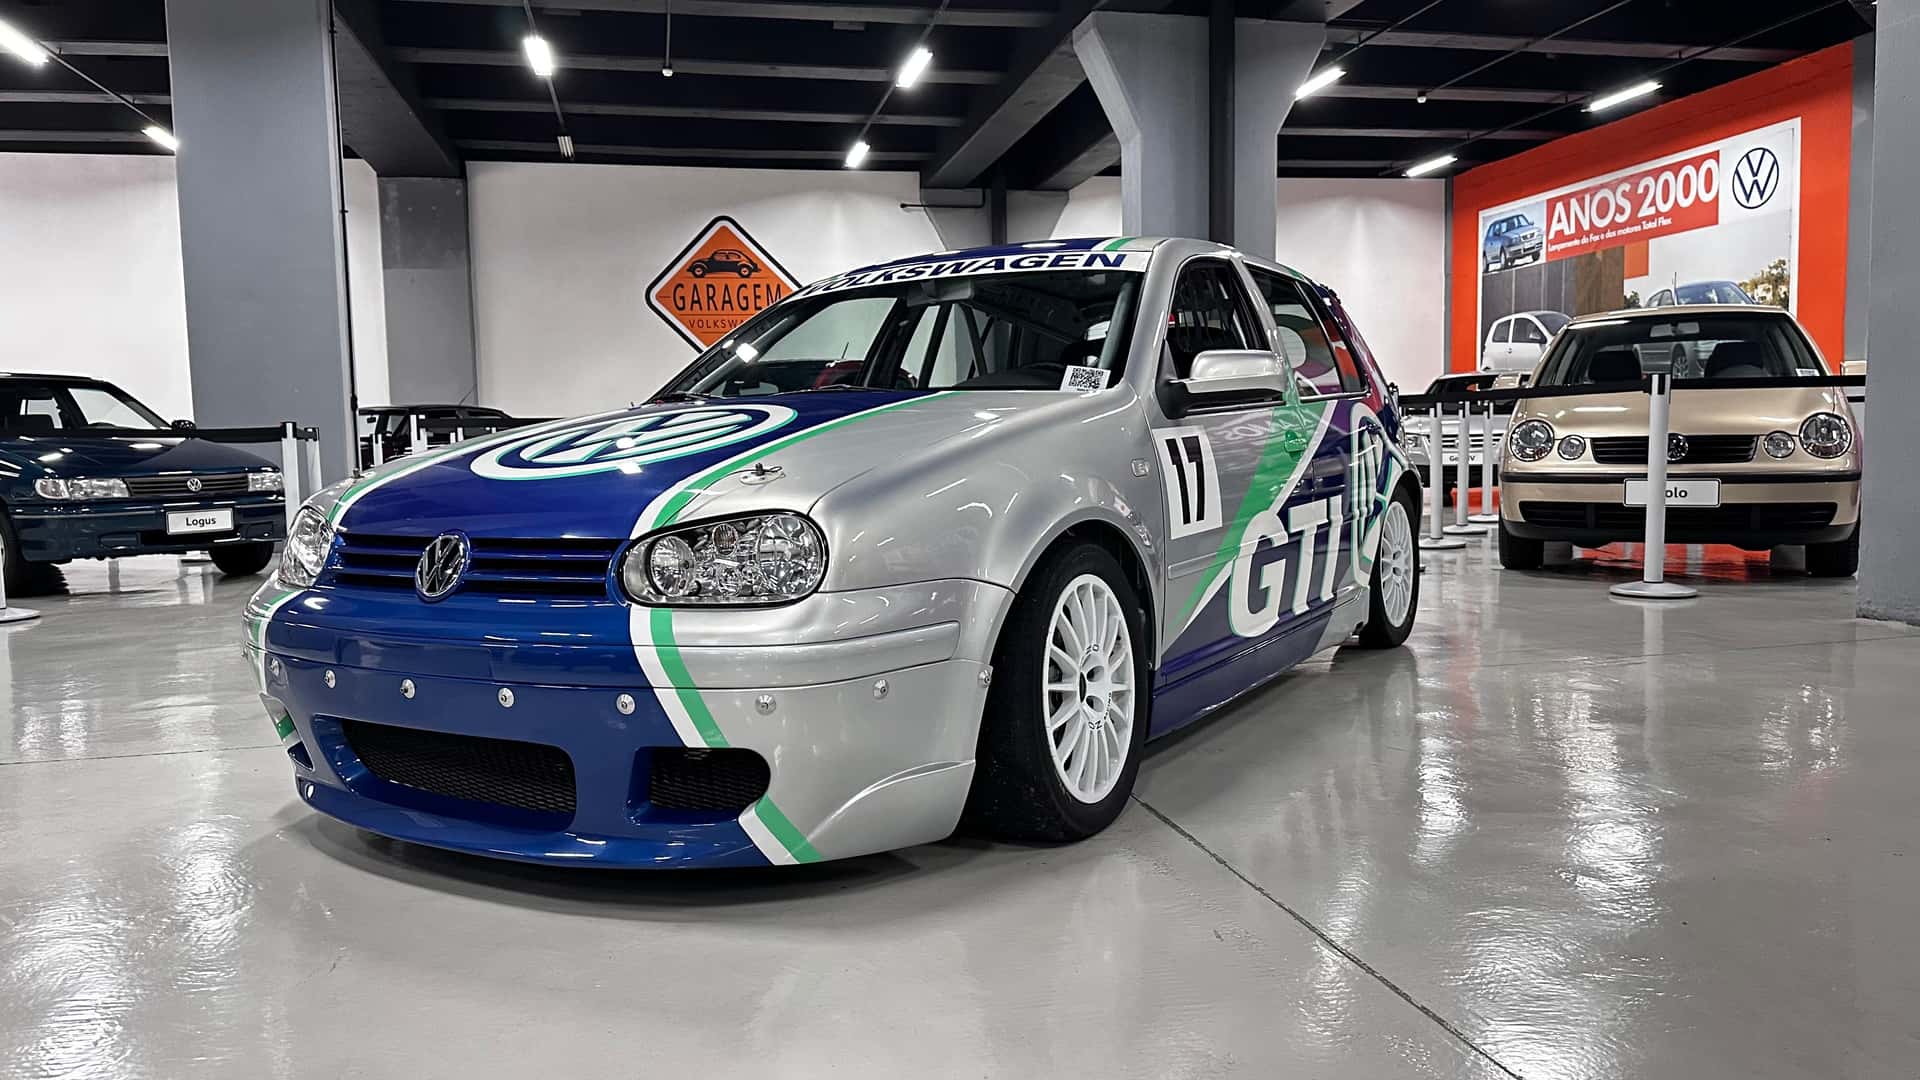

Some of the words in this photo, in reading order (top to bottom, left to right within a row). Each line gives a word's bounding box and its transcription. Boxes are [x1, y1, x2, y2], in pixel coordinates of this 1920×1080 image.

[1548, 182, 1632, 240] ANOS
[1637, 158, 1720, 218] 2000
[1642, 219, 1657, 230] Total
[1658, 217, 1672, 226] Flex
[803, 253, 1127, 296] VOLKSWAGEN
[672, 283, 782, 312] GARAGEM
[1165, 435, 1205, 525] 17
[1665, 487, 1688, 498] olo
[186, 516, 217, 528] Logus
[1229, 495, 1344, 638] GTI
